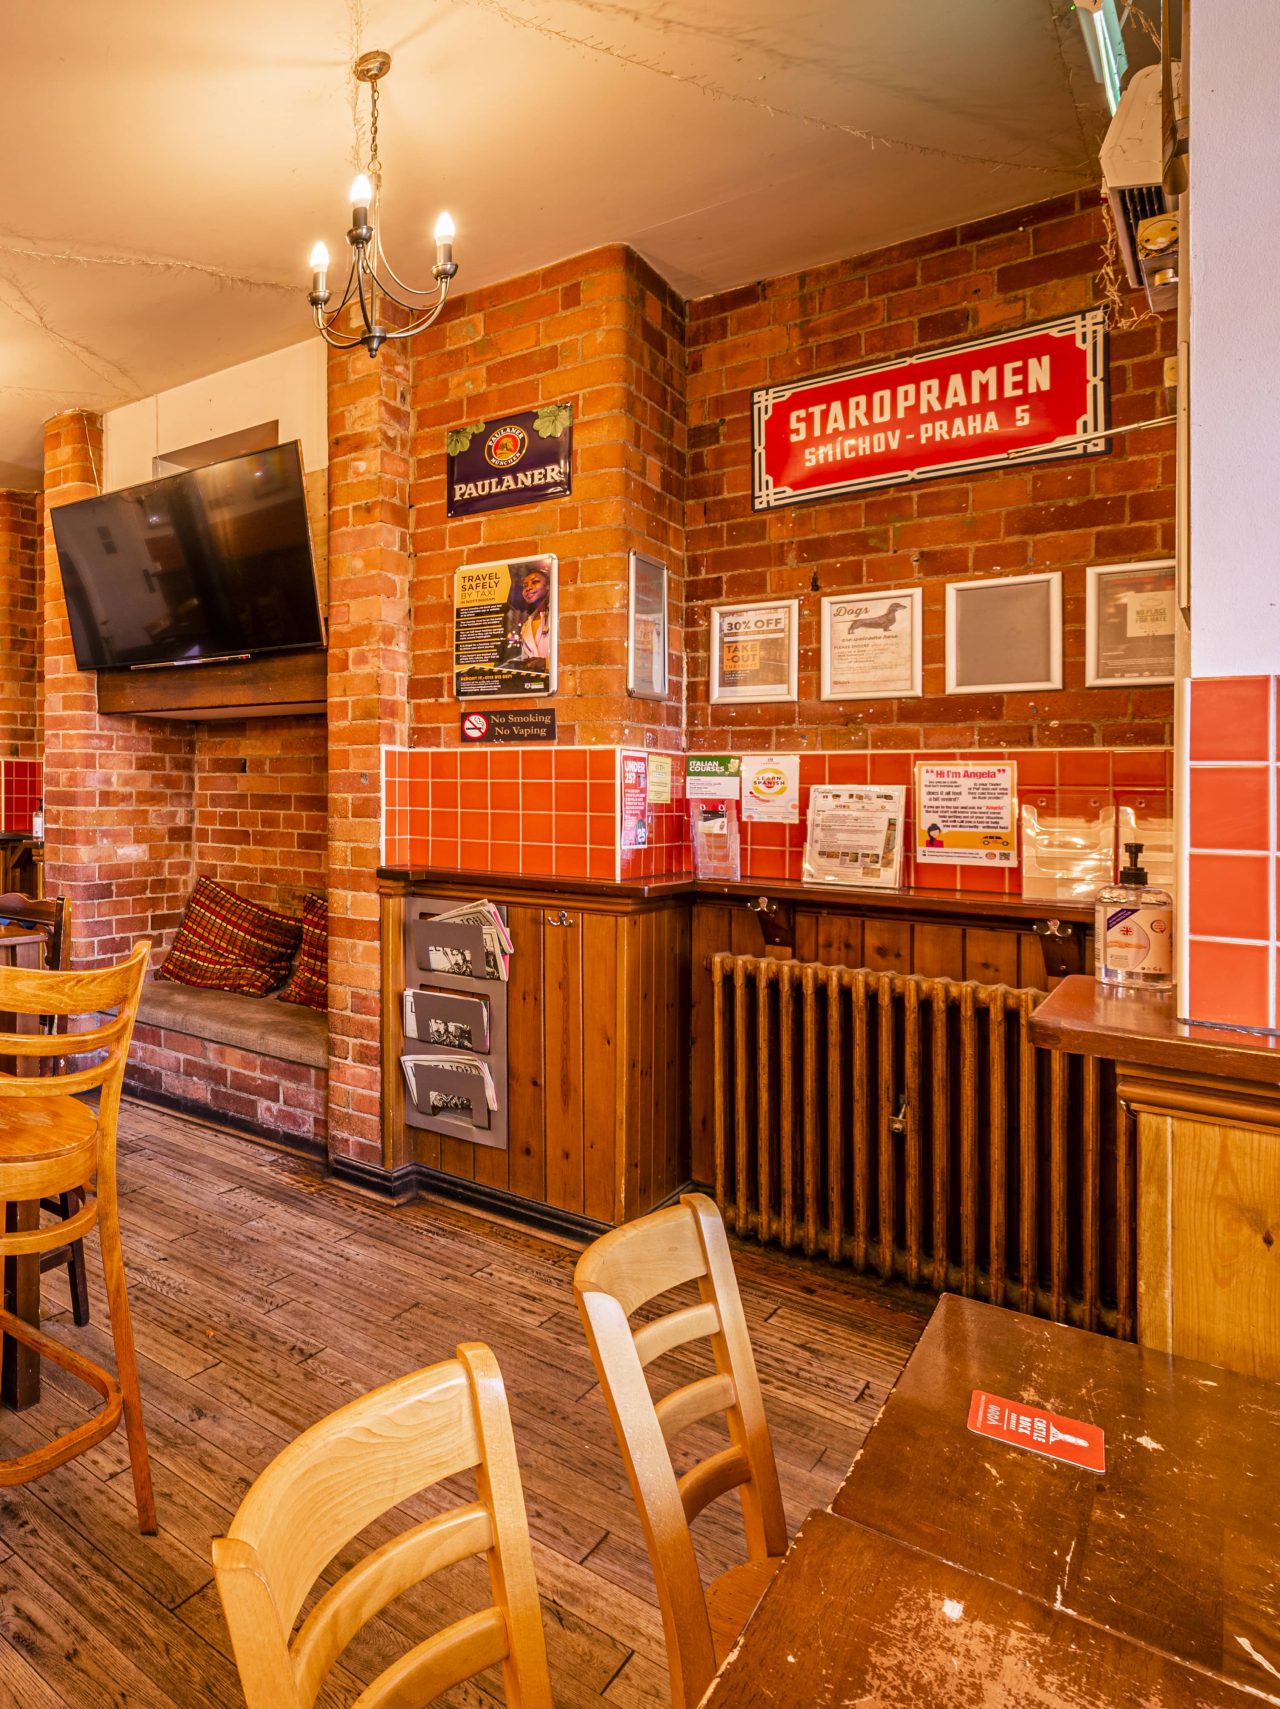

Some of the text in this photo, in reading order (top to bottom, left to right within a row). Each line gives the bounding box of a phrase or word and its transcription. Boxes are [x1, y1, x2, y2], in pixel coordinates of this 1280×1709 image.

[790, 355, 1051, 443] STAROPRAMEN
[921, 411, 999, 444] PRAHA
[1016, 404, 1030, 428] 5
[488, 427, 524, 447] PAULANER
[454, 464, 564, 501] PAULANER
[461, 572, 500, 584] TRAVEL
[461, 580, 500, 592] SAFELY
[461, 589, 496, 600] BY TAXI
[833, 606, 870, 618] Dogs
[1145, 608, 1167, 616] PLACE
[726, 617, 782, 632] 30% OFF
[726, 643, 758, 654] TAKE
[726, 654, 757, 664] -OUT
[490, 714, 552, 725] No Smoking
[495, 726, 547, 737] No Vaping
[624, 761, 646, 773] UNDER
[946, 770, 961, 778] I'm
[1009, 1413, 1018, 1431] BREWERY
[1018, 1415, 1032, 1436] ROCK
[1033, 1416, 1047, 1444] CASTLE
